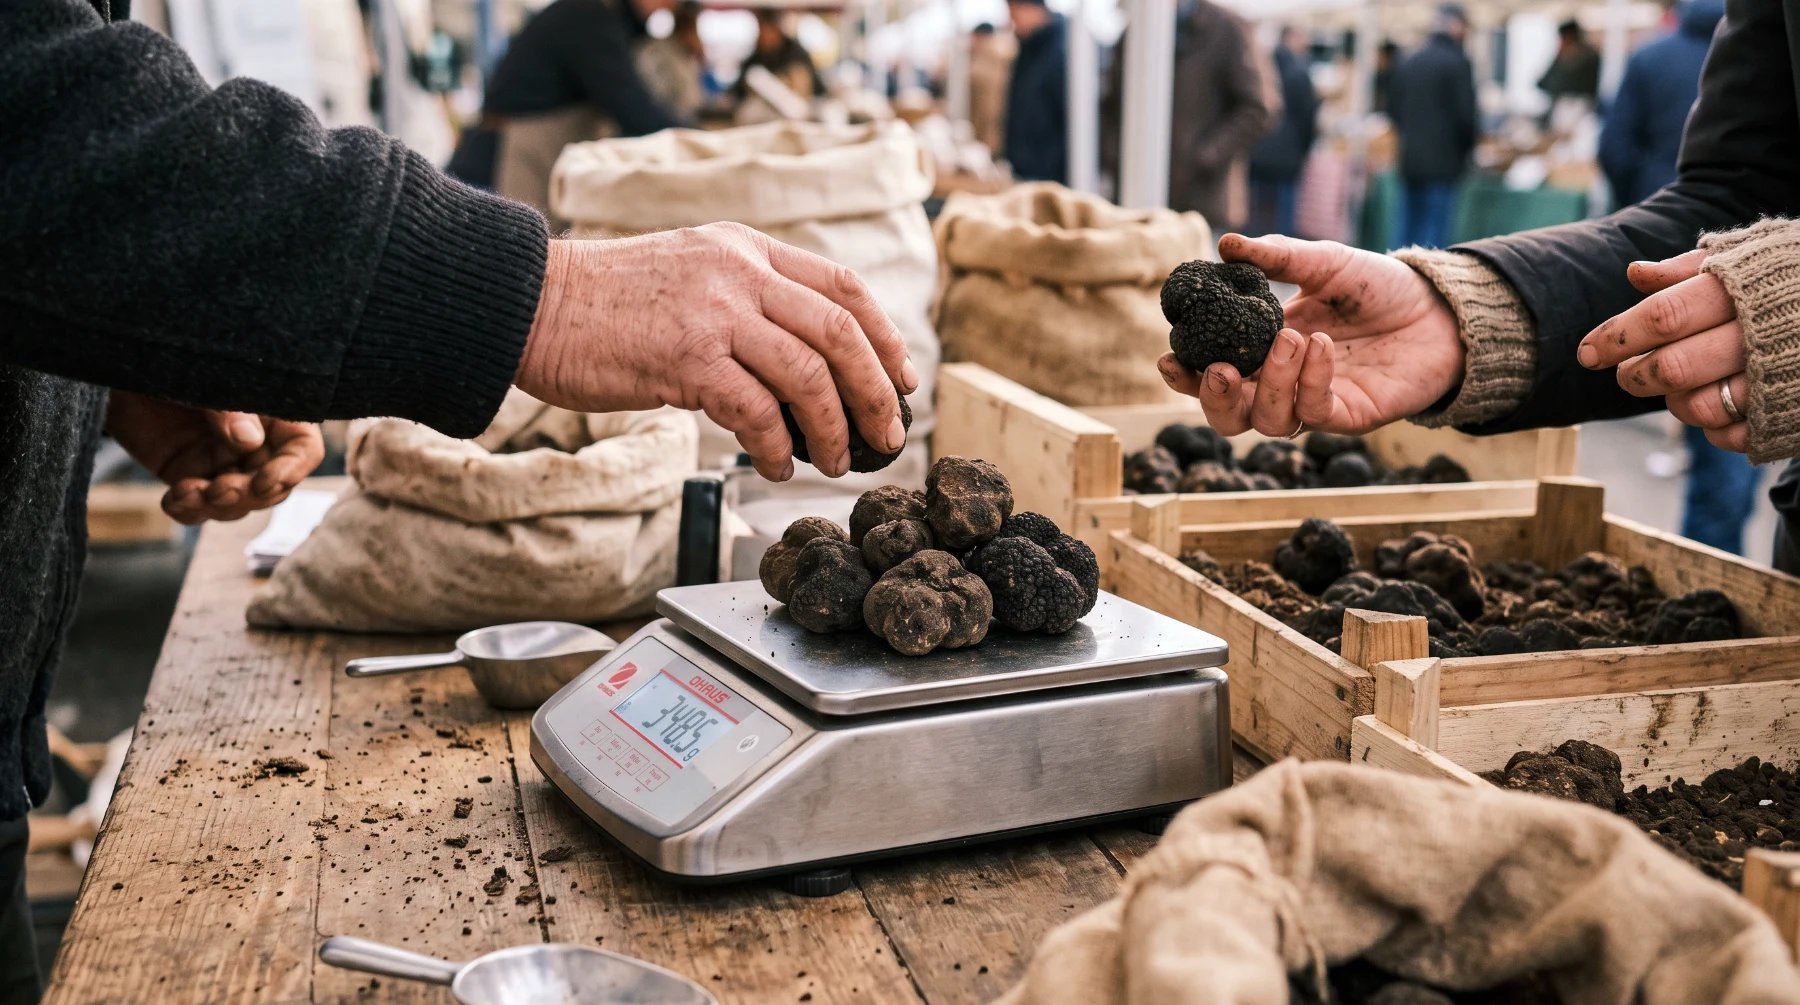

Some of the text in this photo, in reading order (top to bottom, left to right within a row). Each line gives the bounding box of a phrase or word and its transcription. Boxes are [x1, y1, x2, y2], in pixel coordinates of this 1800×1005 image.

[688, 675, 729, 704] OHAUS
[642, 694, 719, 762] 348.5 g
